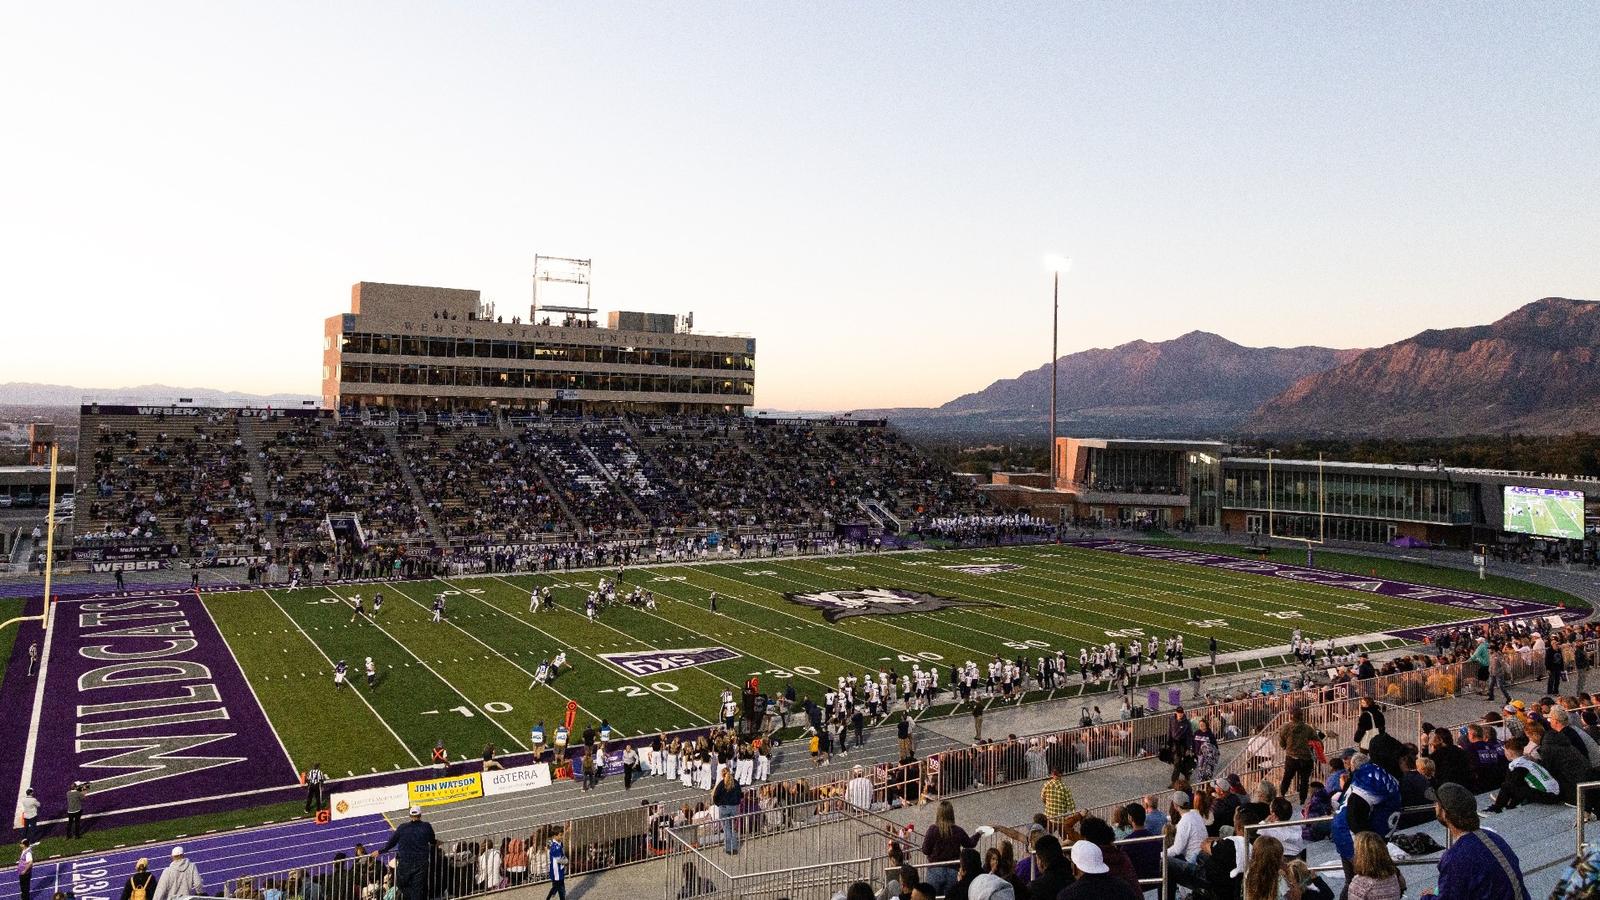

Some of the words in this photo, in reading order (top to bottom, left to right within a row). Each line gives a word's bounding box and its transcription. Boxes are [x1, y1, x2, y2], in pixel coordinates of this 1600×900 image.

[404, 321, 472, 335] WEBER
[507, 328, 567, 340] STATE
[597, 333, 712, 348] UNIVERSITY
[138, 407, 195, 416] WEBER
[242, 409, 285, 417] STATE
[1540, 472, 1568, 481] SHAW
[93, 561, 160, 572] WEBER
[1003, 639, 1051, 650] 50
[897, 651, 944, 663] 40
[765, 665, 821, 679] 30
[617, 682, 680, 697] 20
[75, 599, 249, 797] WILDCATS
[448, 701, 515, 718] 10
[414, 783, 438, 793] JOHN
[439, 777, 476, 789] WATSON
[318, 809, 329, 822] G
